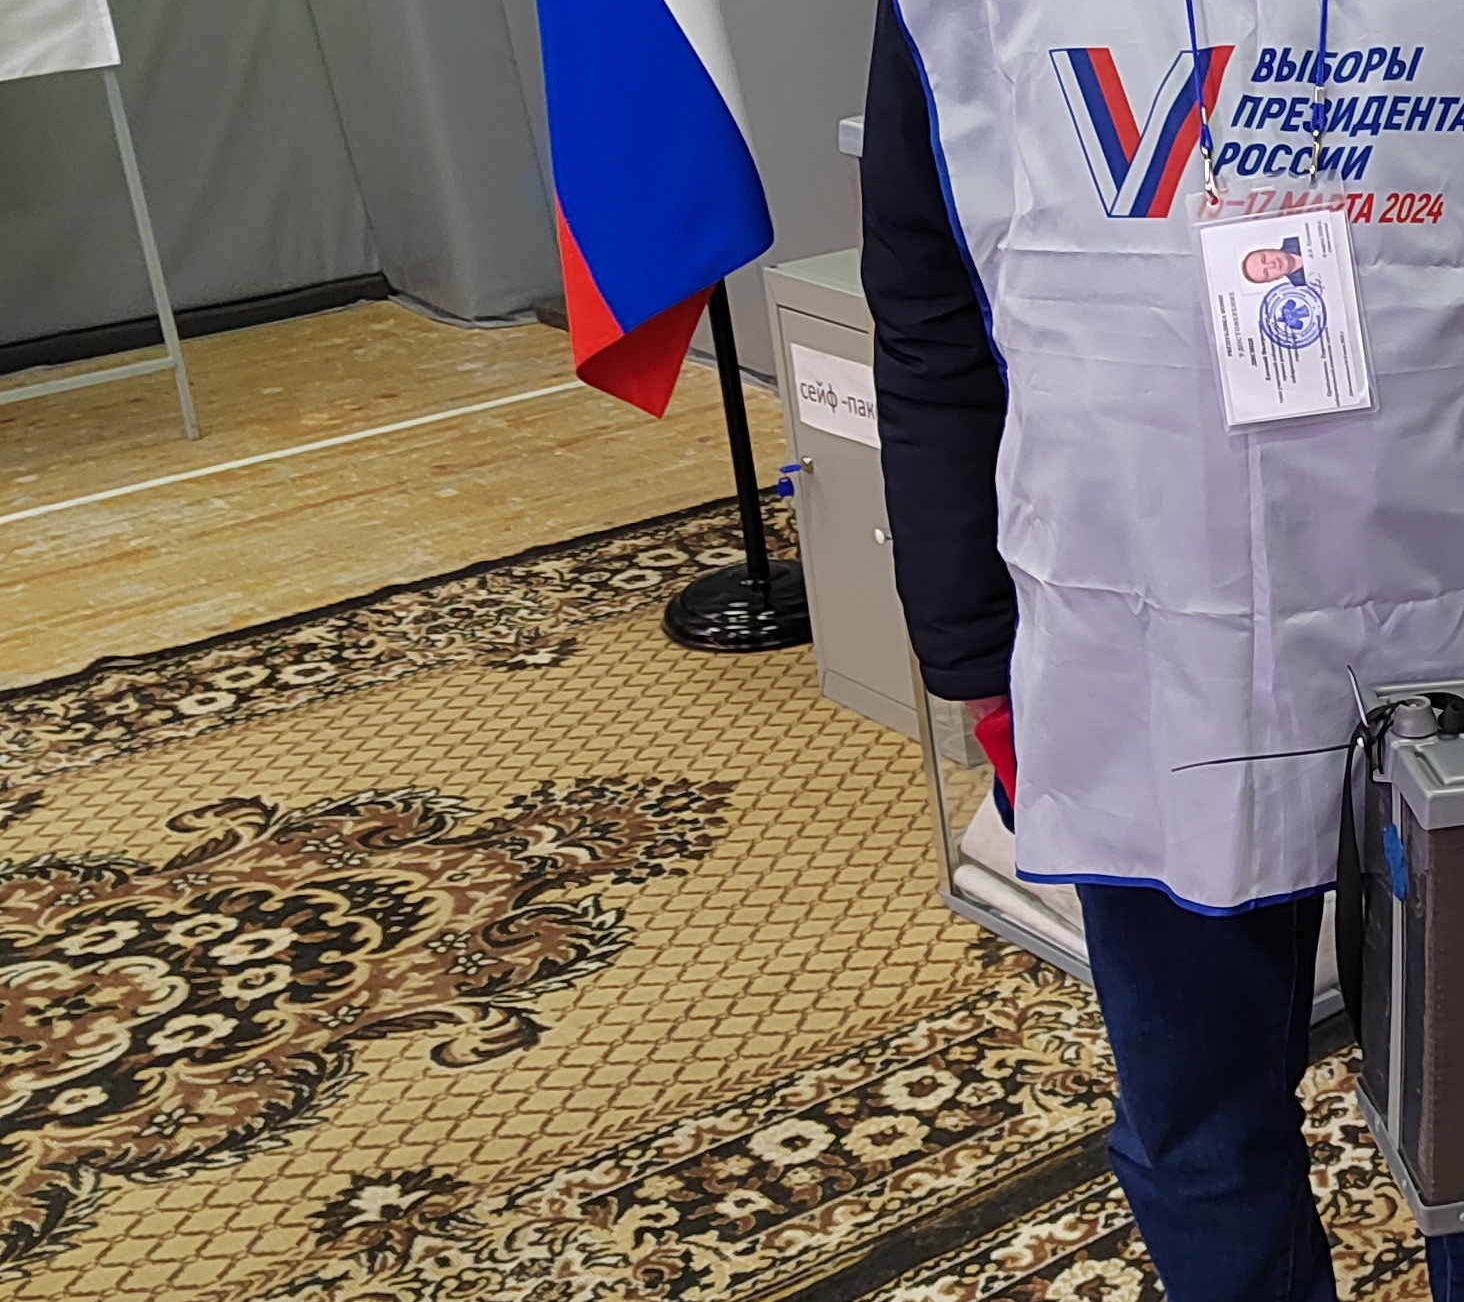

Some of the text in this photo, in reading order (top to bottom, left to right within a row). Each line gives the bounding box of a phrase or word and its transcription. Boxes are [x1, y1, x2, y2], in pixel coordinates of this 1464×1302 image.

[1250, 46, 1425, 84] ВЫБОРЫ
[1214, 141, 1374, 181] РОССИИ
[1378, 192, 1444, 225] 2024
[1228, 291, 1245, 357] УДОСТОВЕРЕНИЕ
[800, 379, 838, 413] сейф
